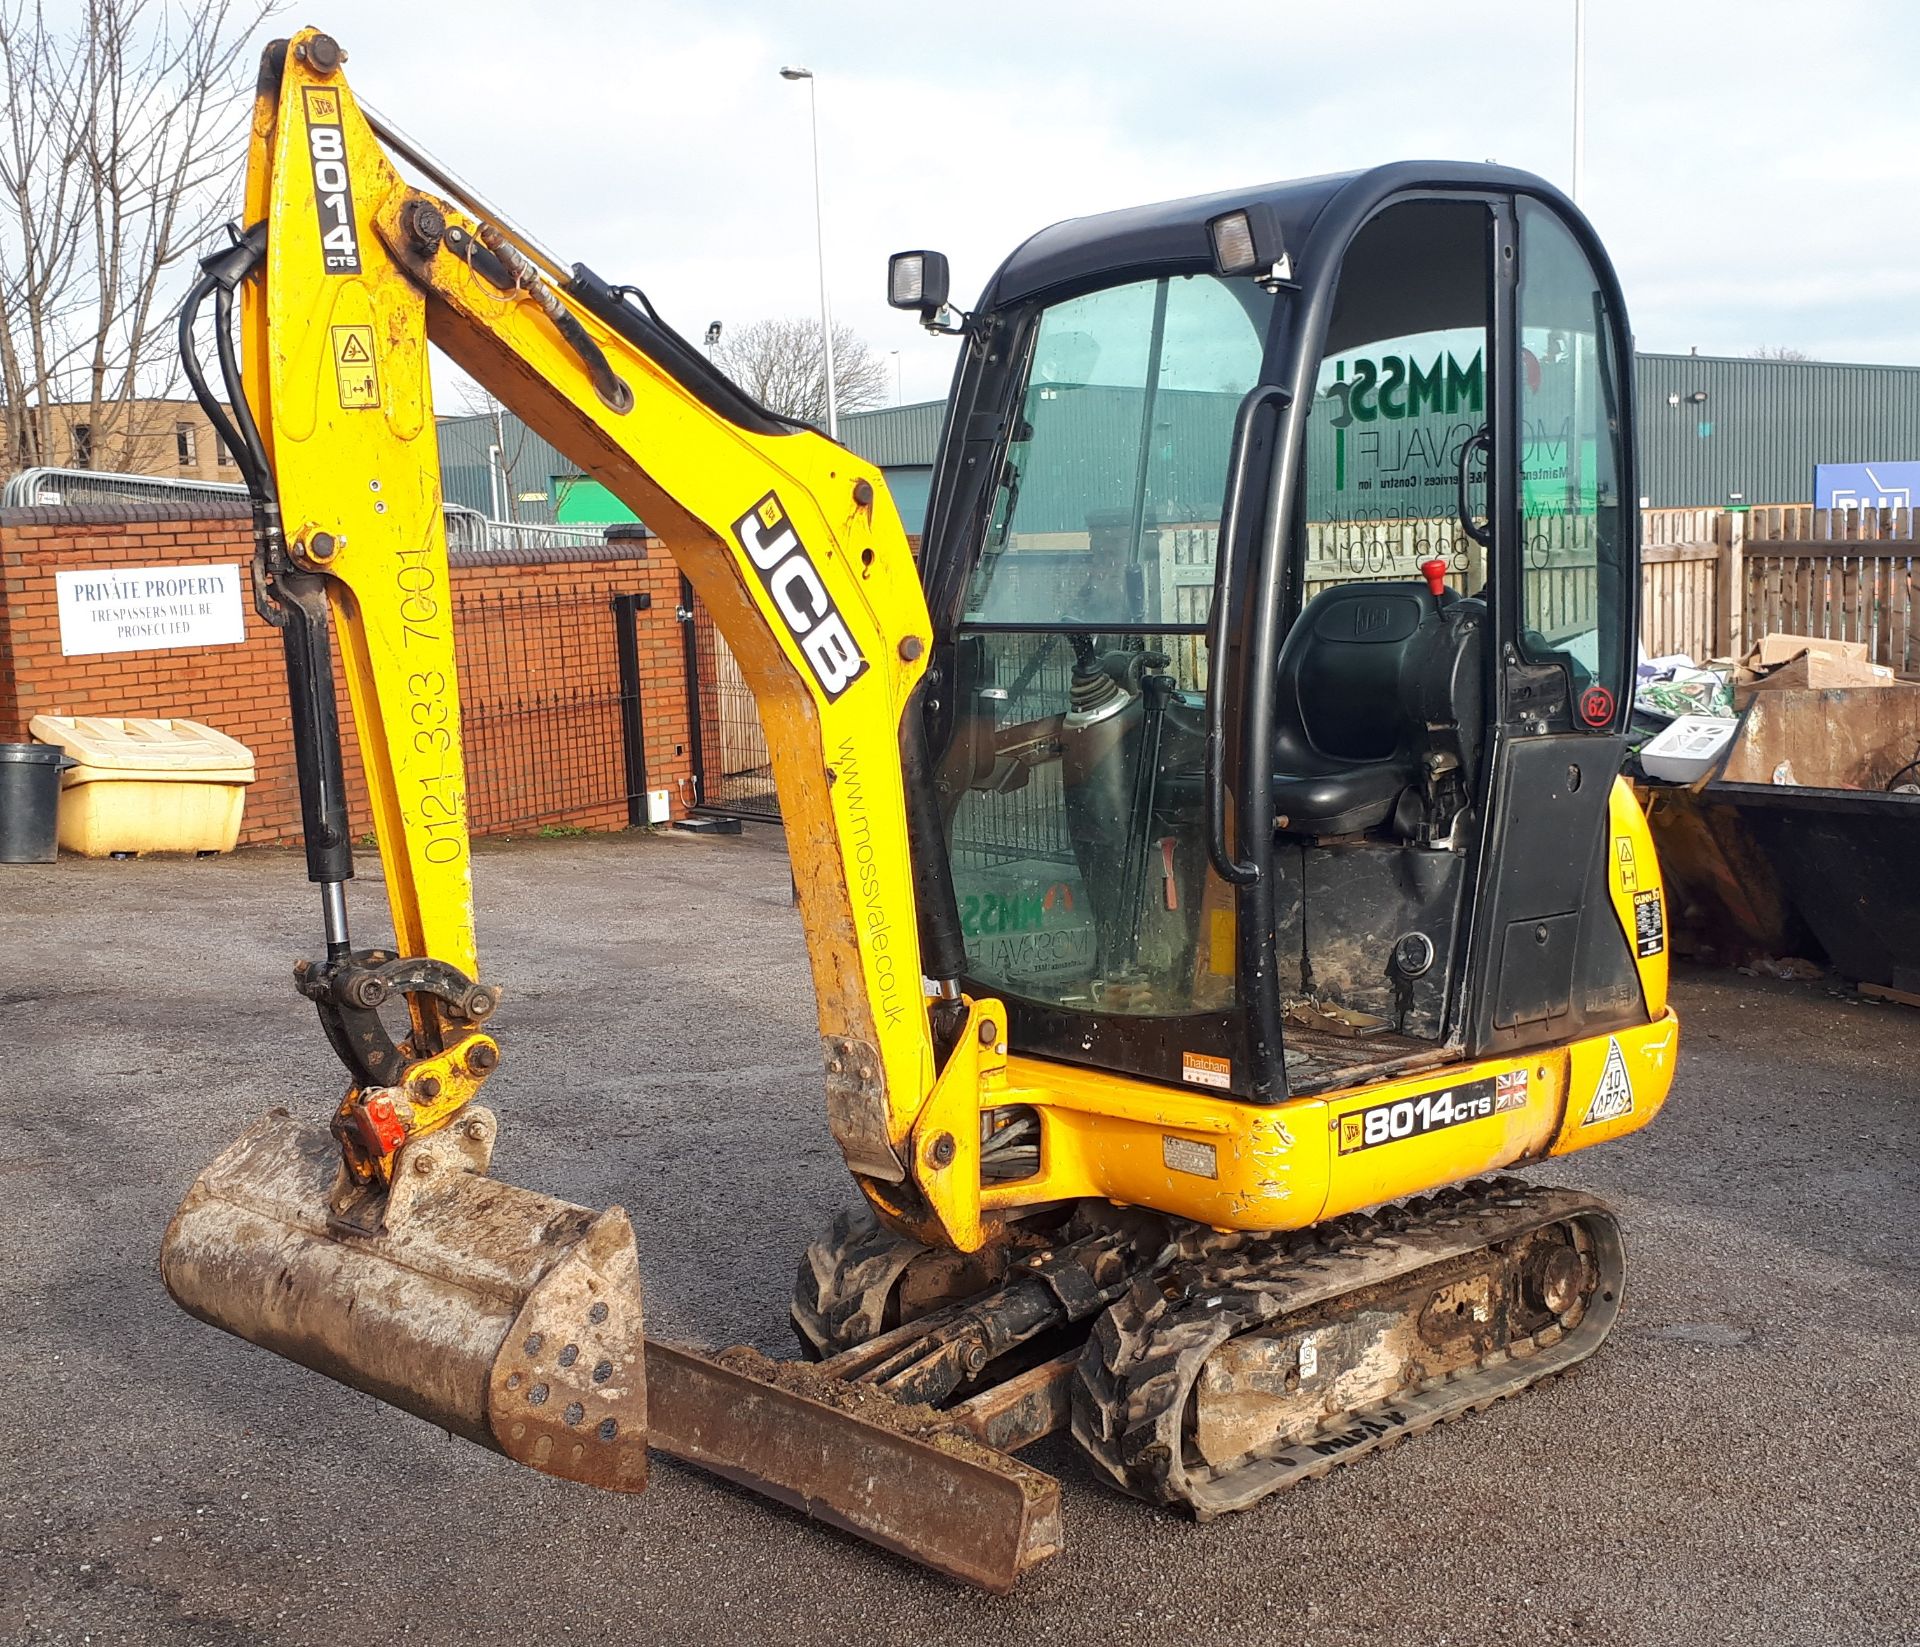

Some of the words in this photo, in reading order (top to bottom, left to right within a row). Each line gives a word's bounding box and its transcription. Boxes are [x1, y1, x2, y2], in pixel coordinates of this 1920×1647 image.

[315, 98, 335, 116] JCB
[310, 127, 356, 256] 8014
[326, 256, 358, 267] CTS
[73, 580, 141, 602] PRIVATE
[145, 576, 226, 598] PROPERTY
[395, 549, 440, 649] 7001
[90, 605, 167, 623] TRESPASSERS
[169, 603, 196, 618] WILL
[199, 602, 213, 616] BE
[740, 513, 862, 694] JCB
[117, 621, 190, 639] PROSECUTED
[408, 670, 451, 754] 333
[1588, 696, 1607, 717] 62
[419, 773, 462, 864] 0121
[838, 736, 905, 1030] www.mossvale.co.uk
[1184, 1054, 1229, 1074] Thatcham
[1345, 1124, 1360, 1141] JCB
